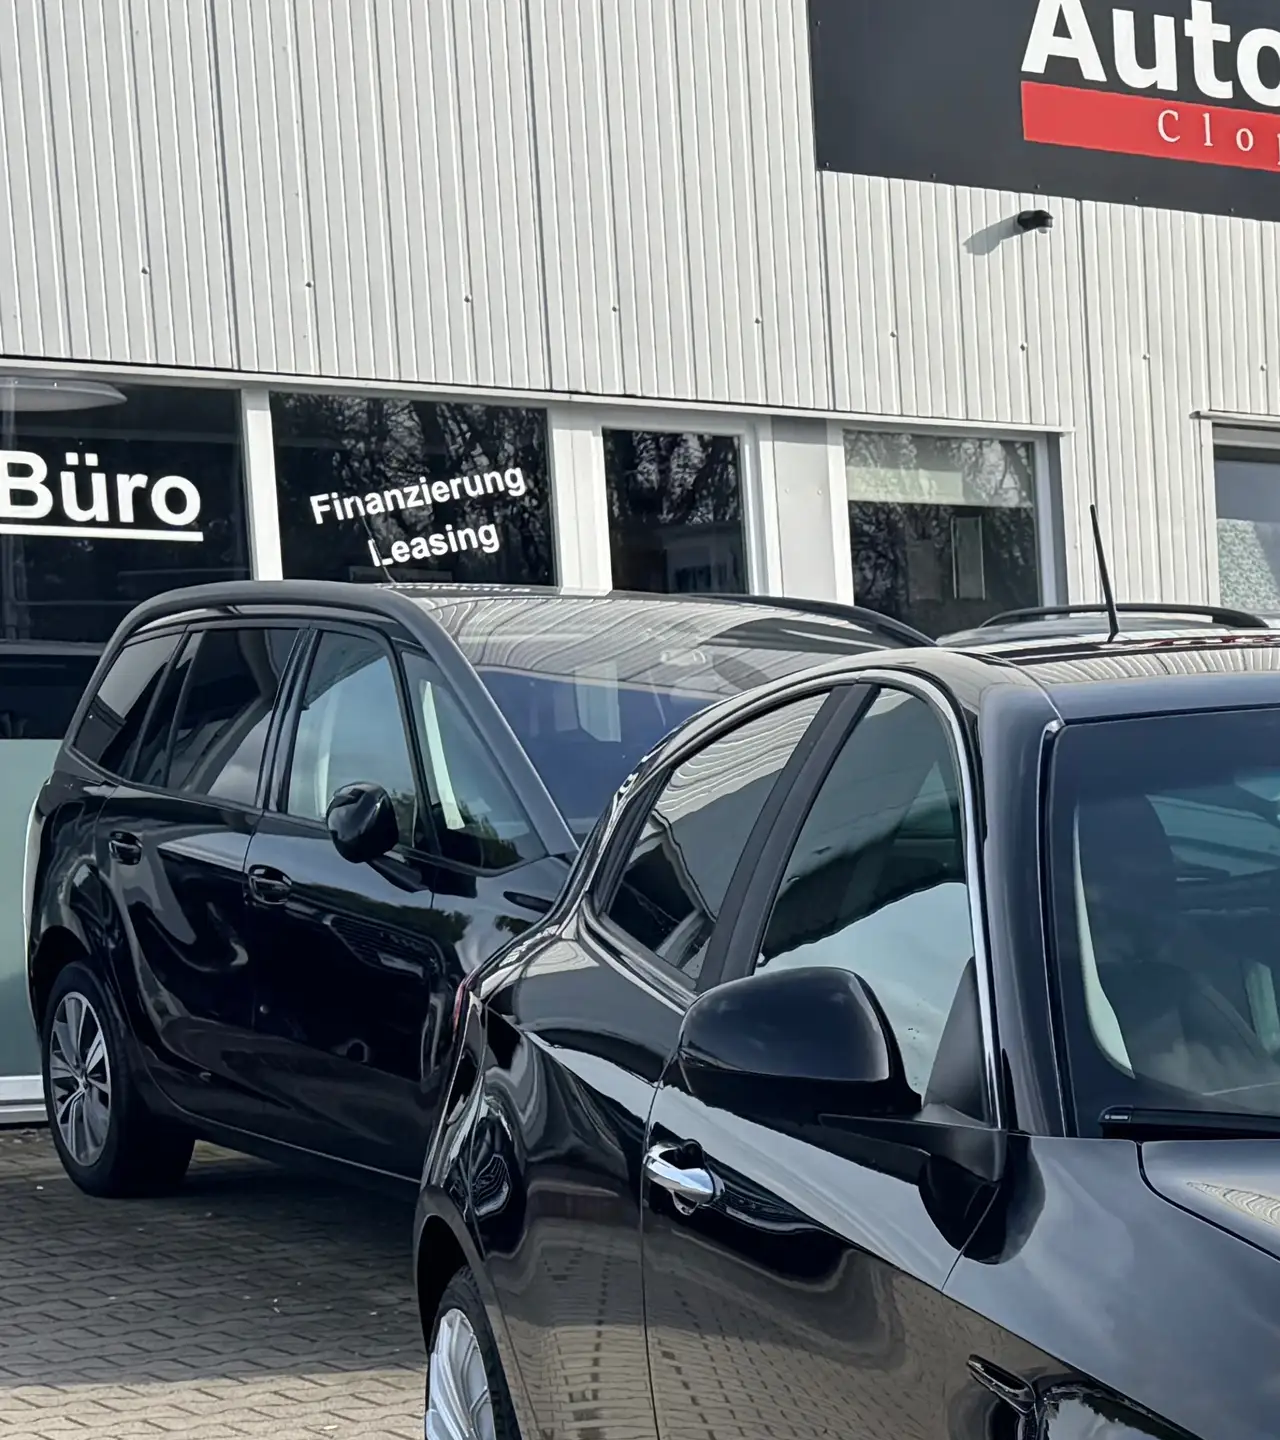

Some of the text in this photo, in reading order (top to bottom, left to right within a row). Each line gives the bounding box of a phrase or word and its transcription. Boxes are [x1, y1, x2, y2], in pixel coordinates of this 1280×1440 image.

[0, 449, 202, 527] Büro
[309, 466, 527, 525] Finanzierung
[367, 522, 500, 567] Leasing
